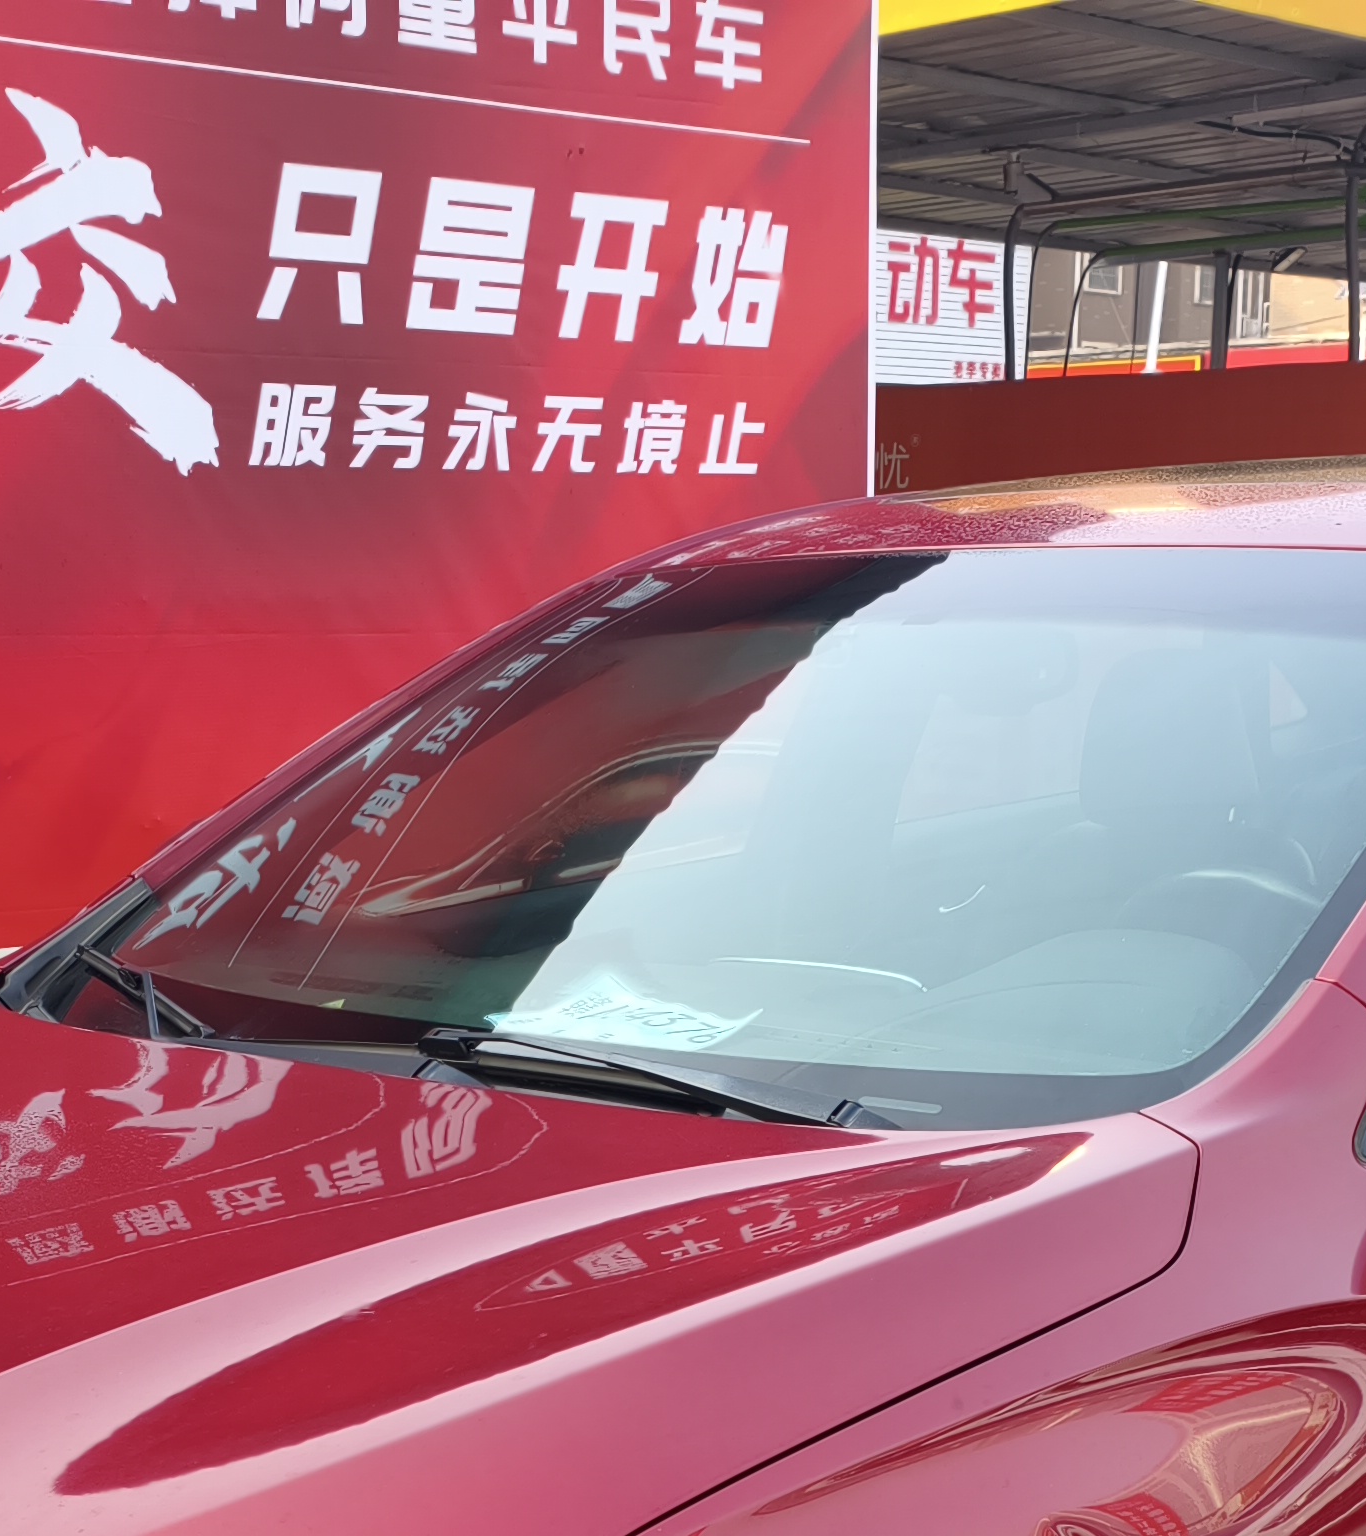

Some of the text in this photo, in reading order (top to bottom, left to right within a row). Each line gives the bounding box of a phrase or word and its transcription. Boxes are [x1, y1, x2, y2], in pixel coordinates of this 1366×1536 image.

[256, 160, 790, 350] 只是开始
[887, 236, 996, 328] 动车
[247, 384, 765, 476] 服务永无境止
